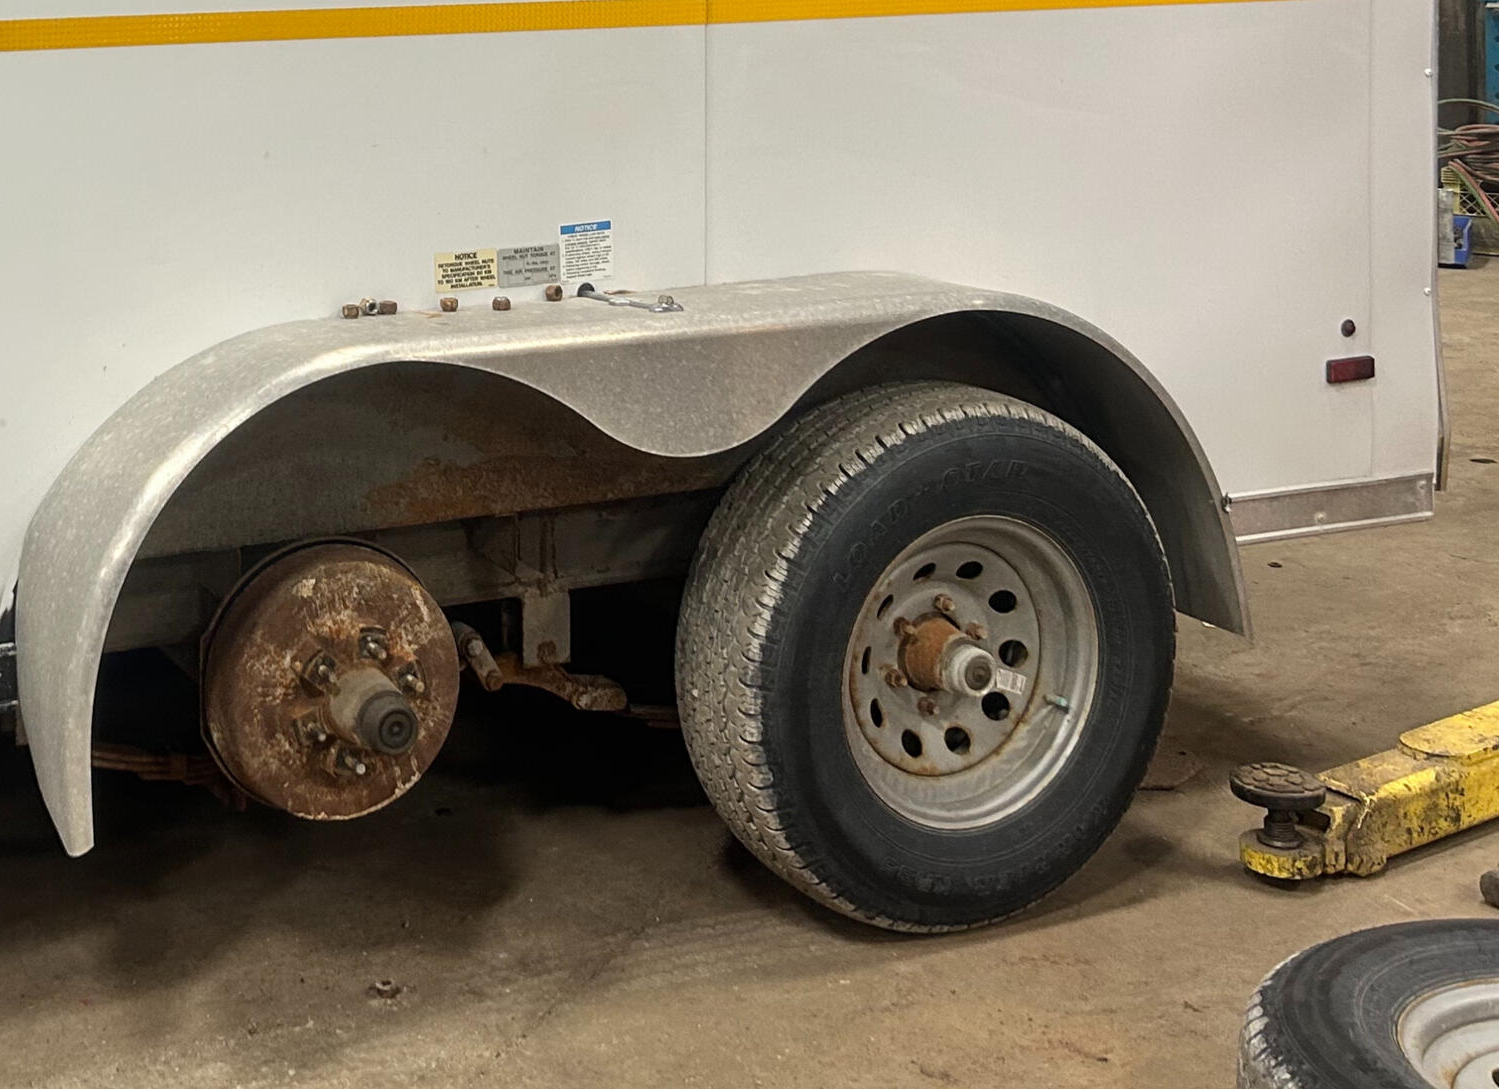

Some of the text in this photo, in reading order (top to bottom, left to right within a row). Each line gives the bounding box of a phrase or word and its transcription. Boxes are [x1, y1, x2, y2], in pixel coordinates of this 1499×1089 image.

[574, 224, 598, 232] NOTICE
[513, 246, 544, 254] MAINTAIN
[455, 252, 477, 260] NOTICE
